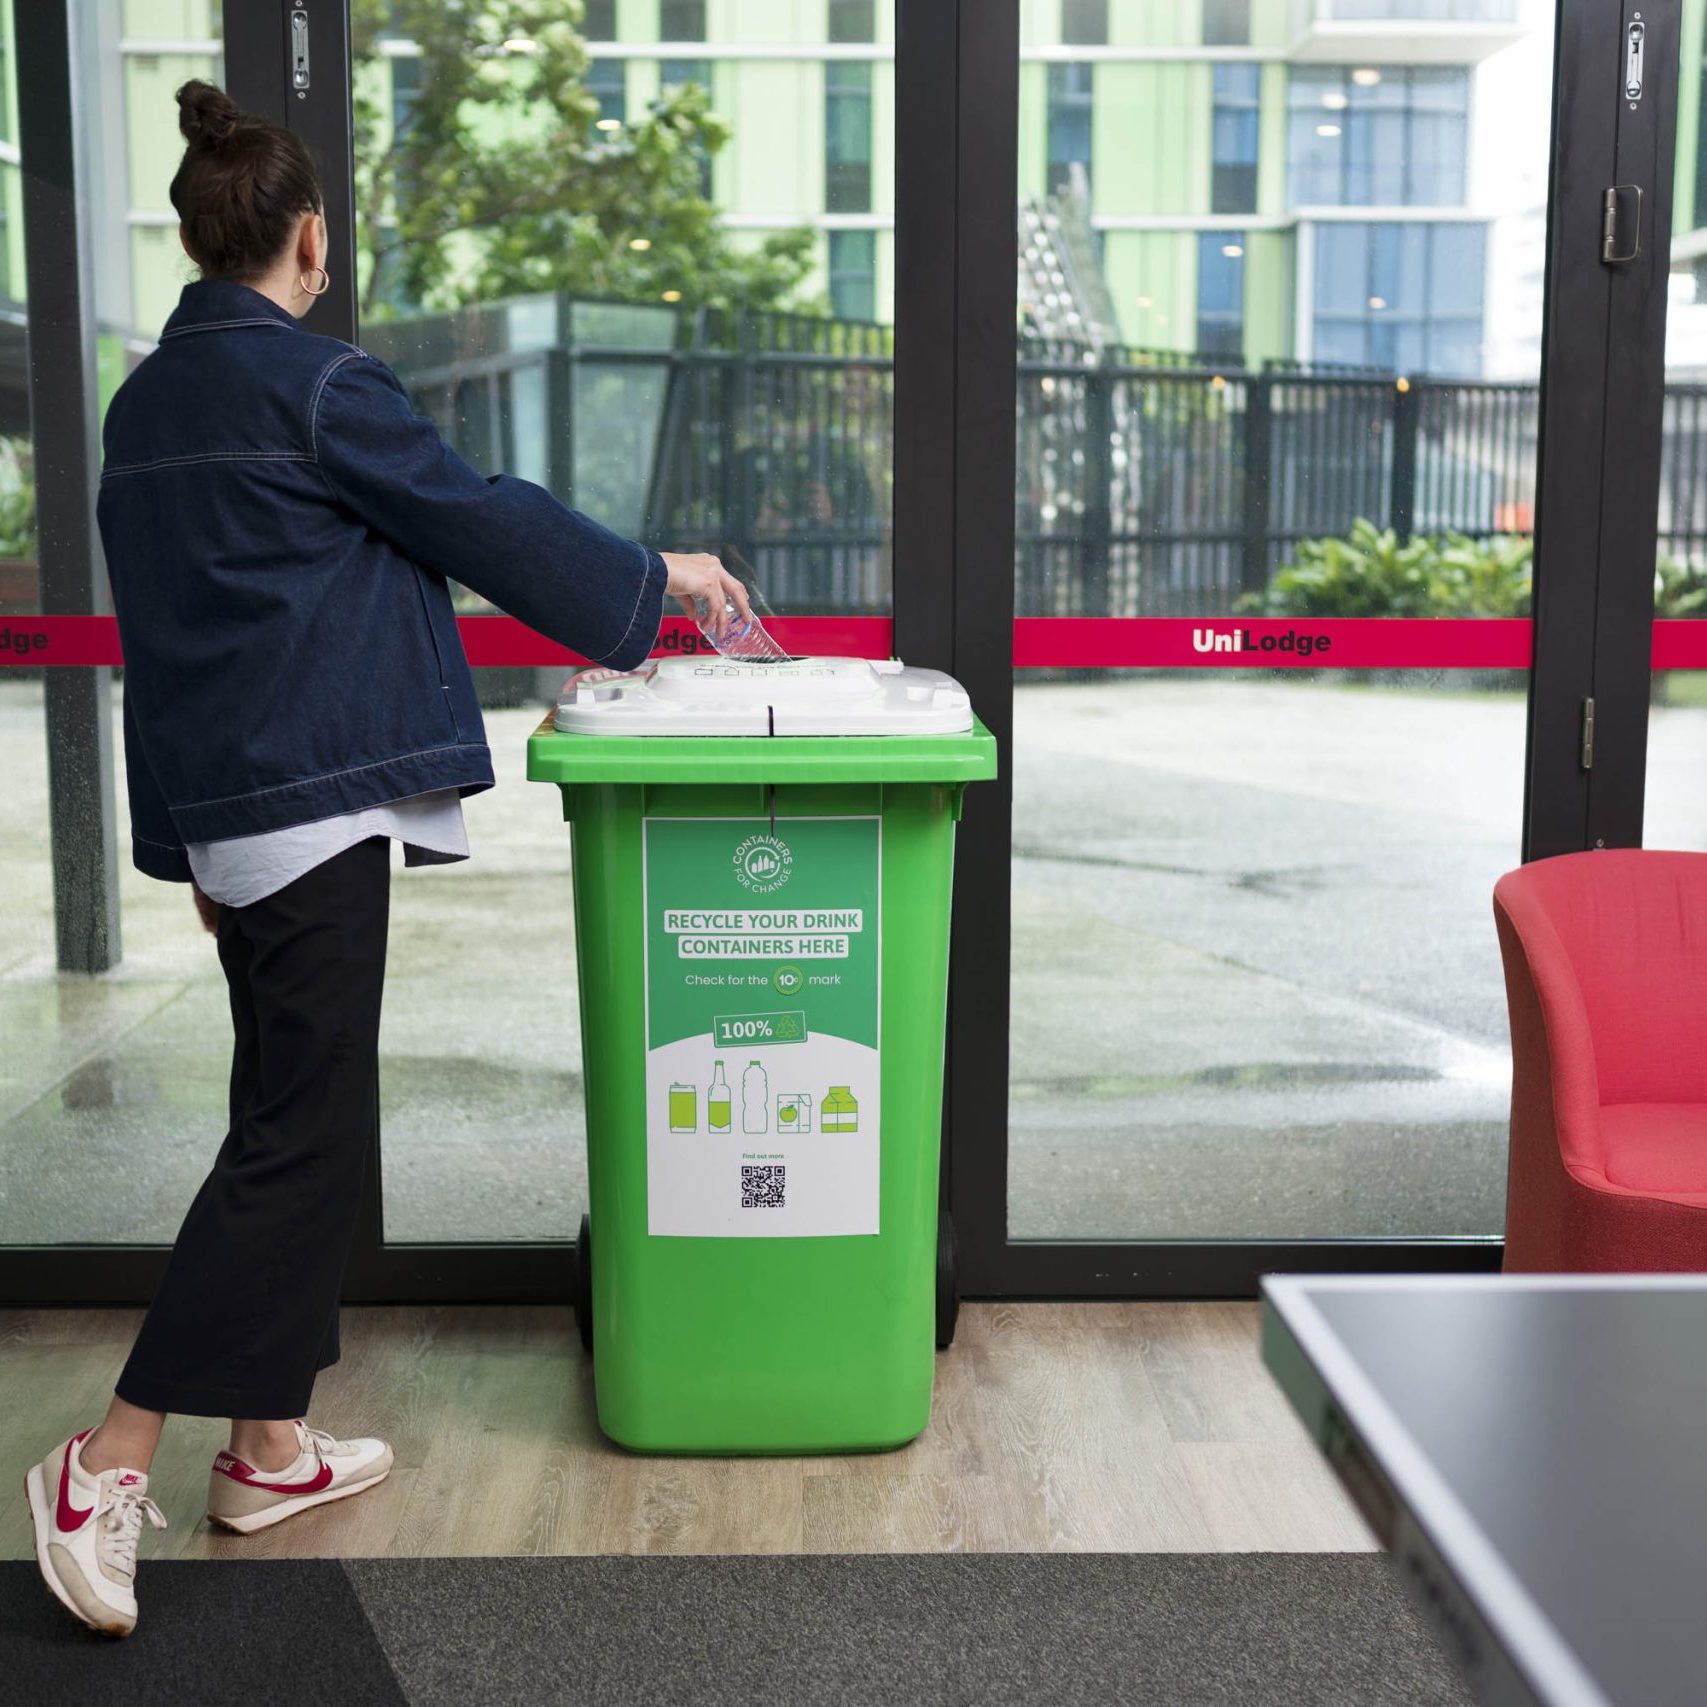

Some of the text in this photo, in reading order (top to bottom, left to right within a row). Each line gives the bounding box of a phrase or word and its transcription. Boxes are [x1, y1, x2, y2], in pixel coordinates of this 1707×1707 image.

[1193, 629, 1332, 656] UniLodge
[732, 834, 793, 865] CONTAINERS
[734, 868, 792, 893] FOR CHANGE
[667, 913, 859, 929] RECYCLE YOUR DRINK
[681, 939, 845, 954] CONTAINERS HERE
[685, 974, 725, 985] Check
[728, 974, 745, 985] for
[748, 974, 768, 985] the
[809, 974, 842, 985] mark
[721, 1020, 773, 1039] 100%
